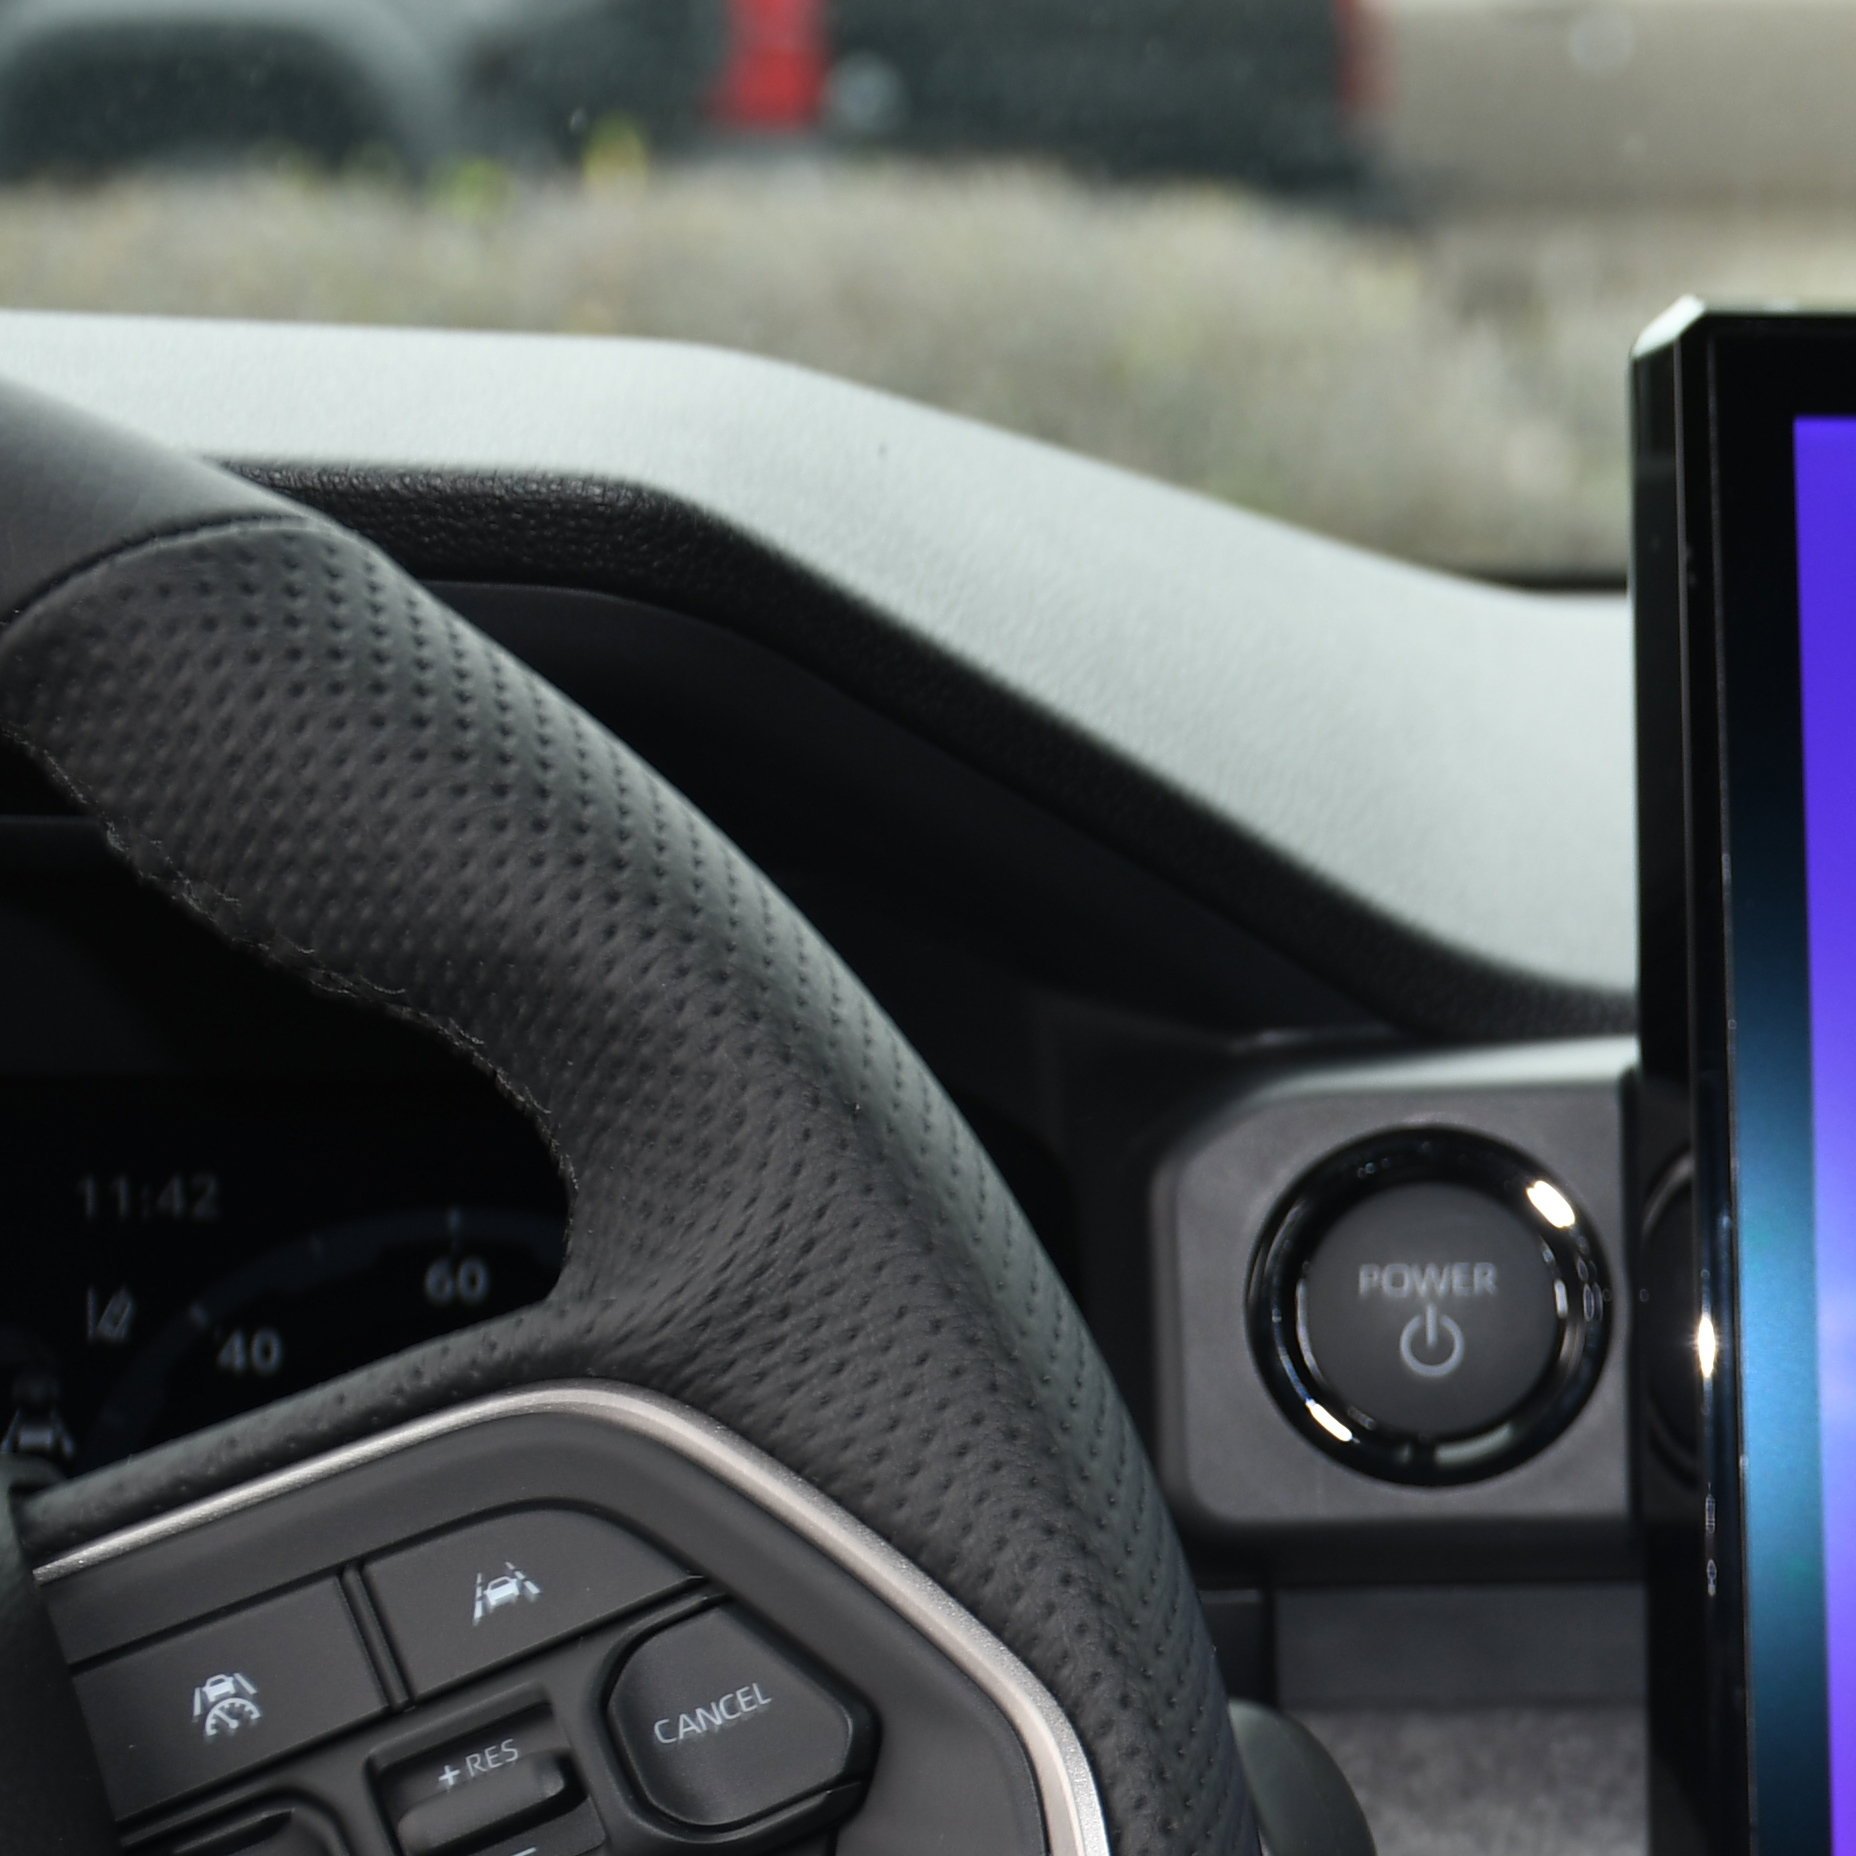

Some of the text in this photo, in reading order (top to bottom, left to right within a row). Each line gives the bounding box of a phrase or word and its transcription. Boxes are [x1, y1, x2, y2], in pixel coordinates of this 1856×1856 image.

[76, 1172, 222, 1222] 11:42
[424, 1255, 488, 1307] 60
[1357, 1260, 1499, 1298] POWER
[216, 1327, 284, 1377] 40
[652, 1680, 772, 1746] CANCEL
